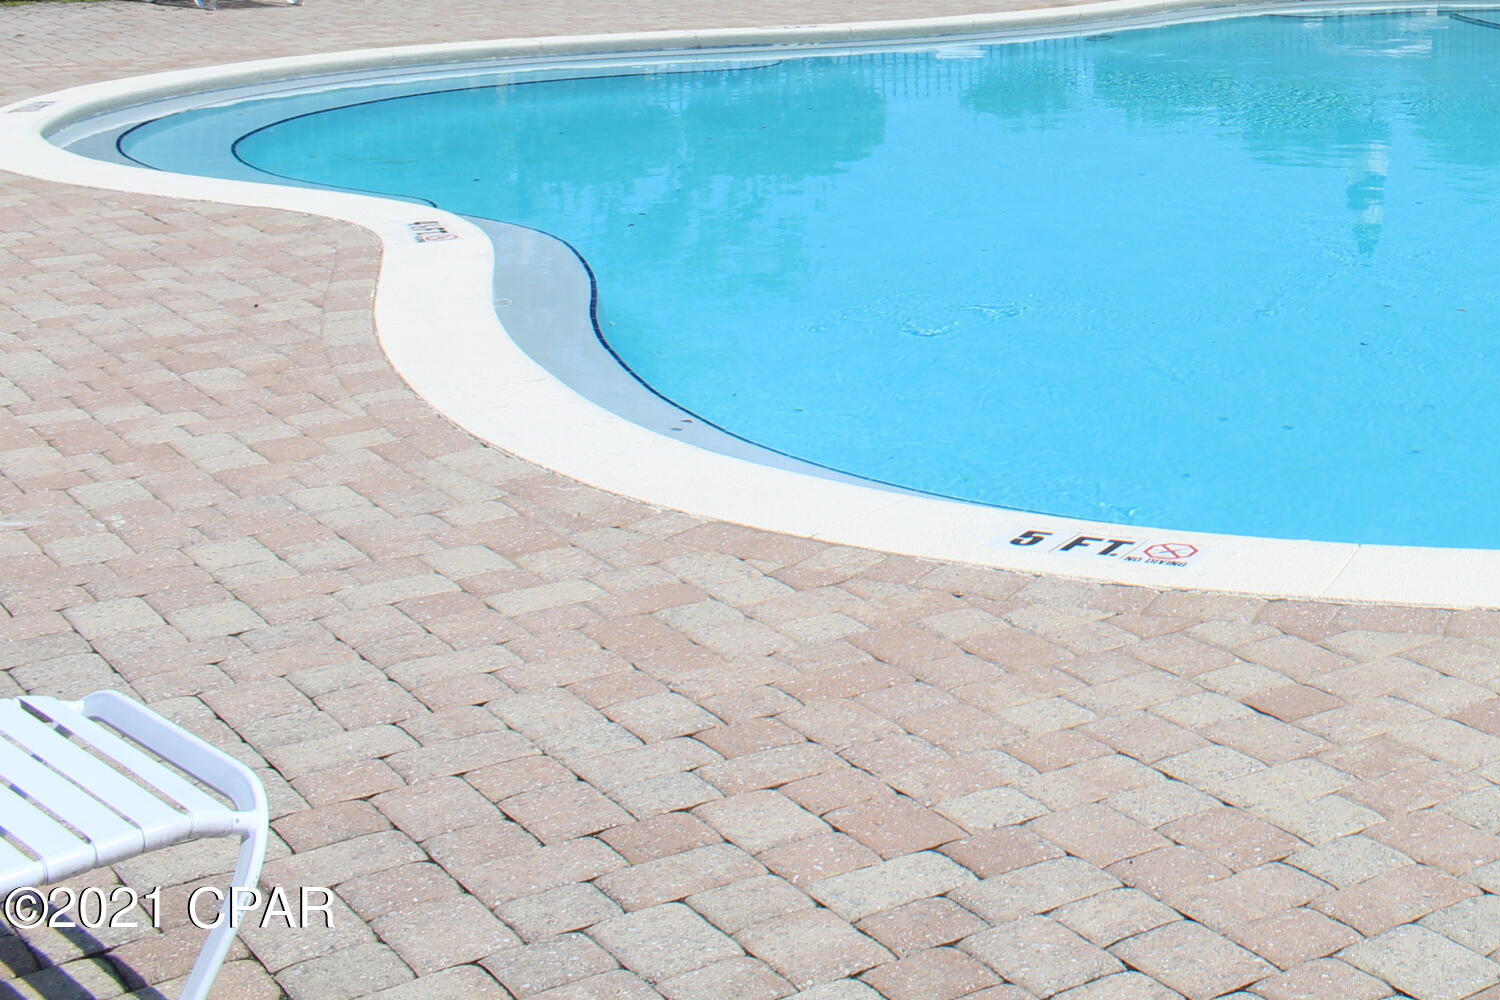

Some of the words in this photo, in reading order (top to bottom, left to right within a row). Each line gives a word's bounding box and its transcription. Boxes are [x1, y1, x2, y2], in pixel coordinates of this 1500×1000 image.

[1010, 530, 1053, 546] 5
[1060, 535, 1136, 557] FT.
[1145, 558, 1188, 567] DIVING
